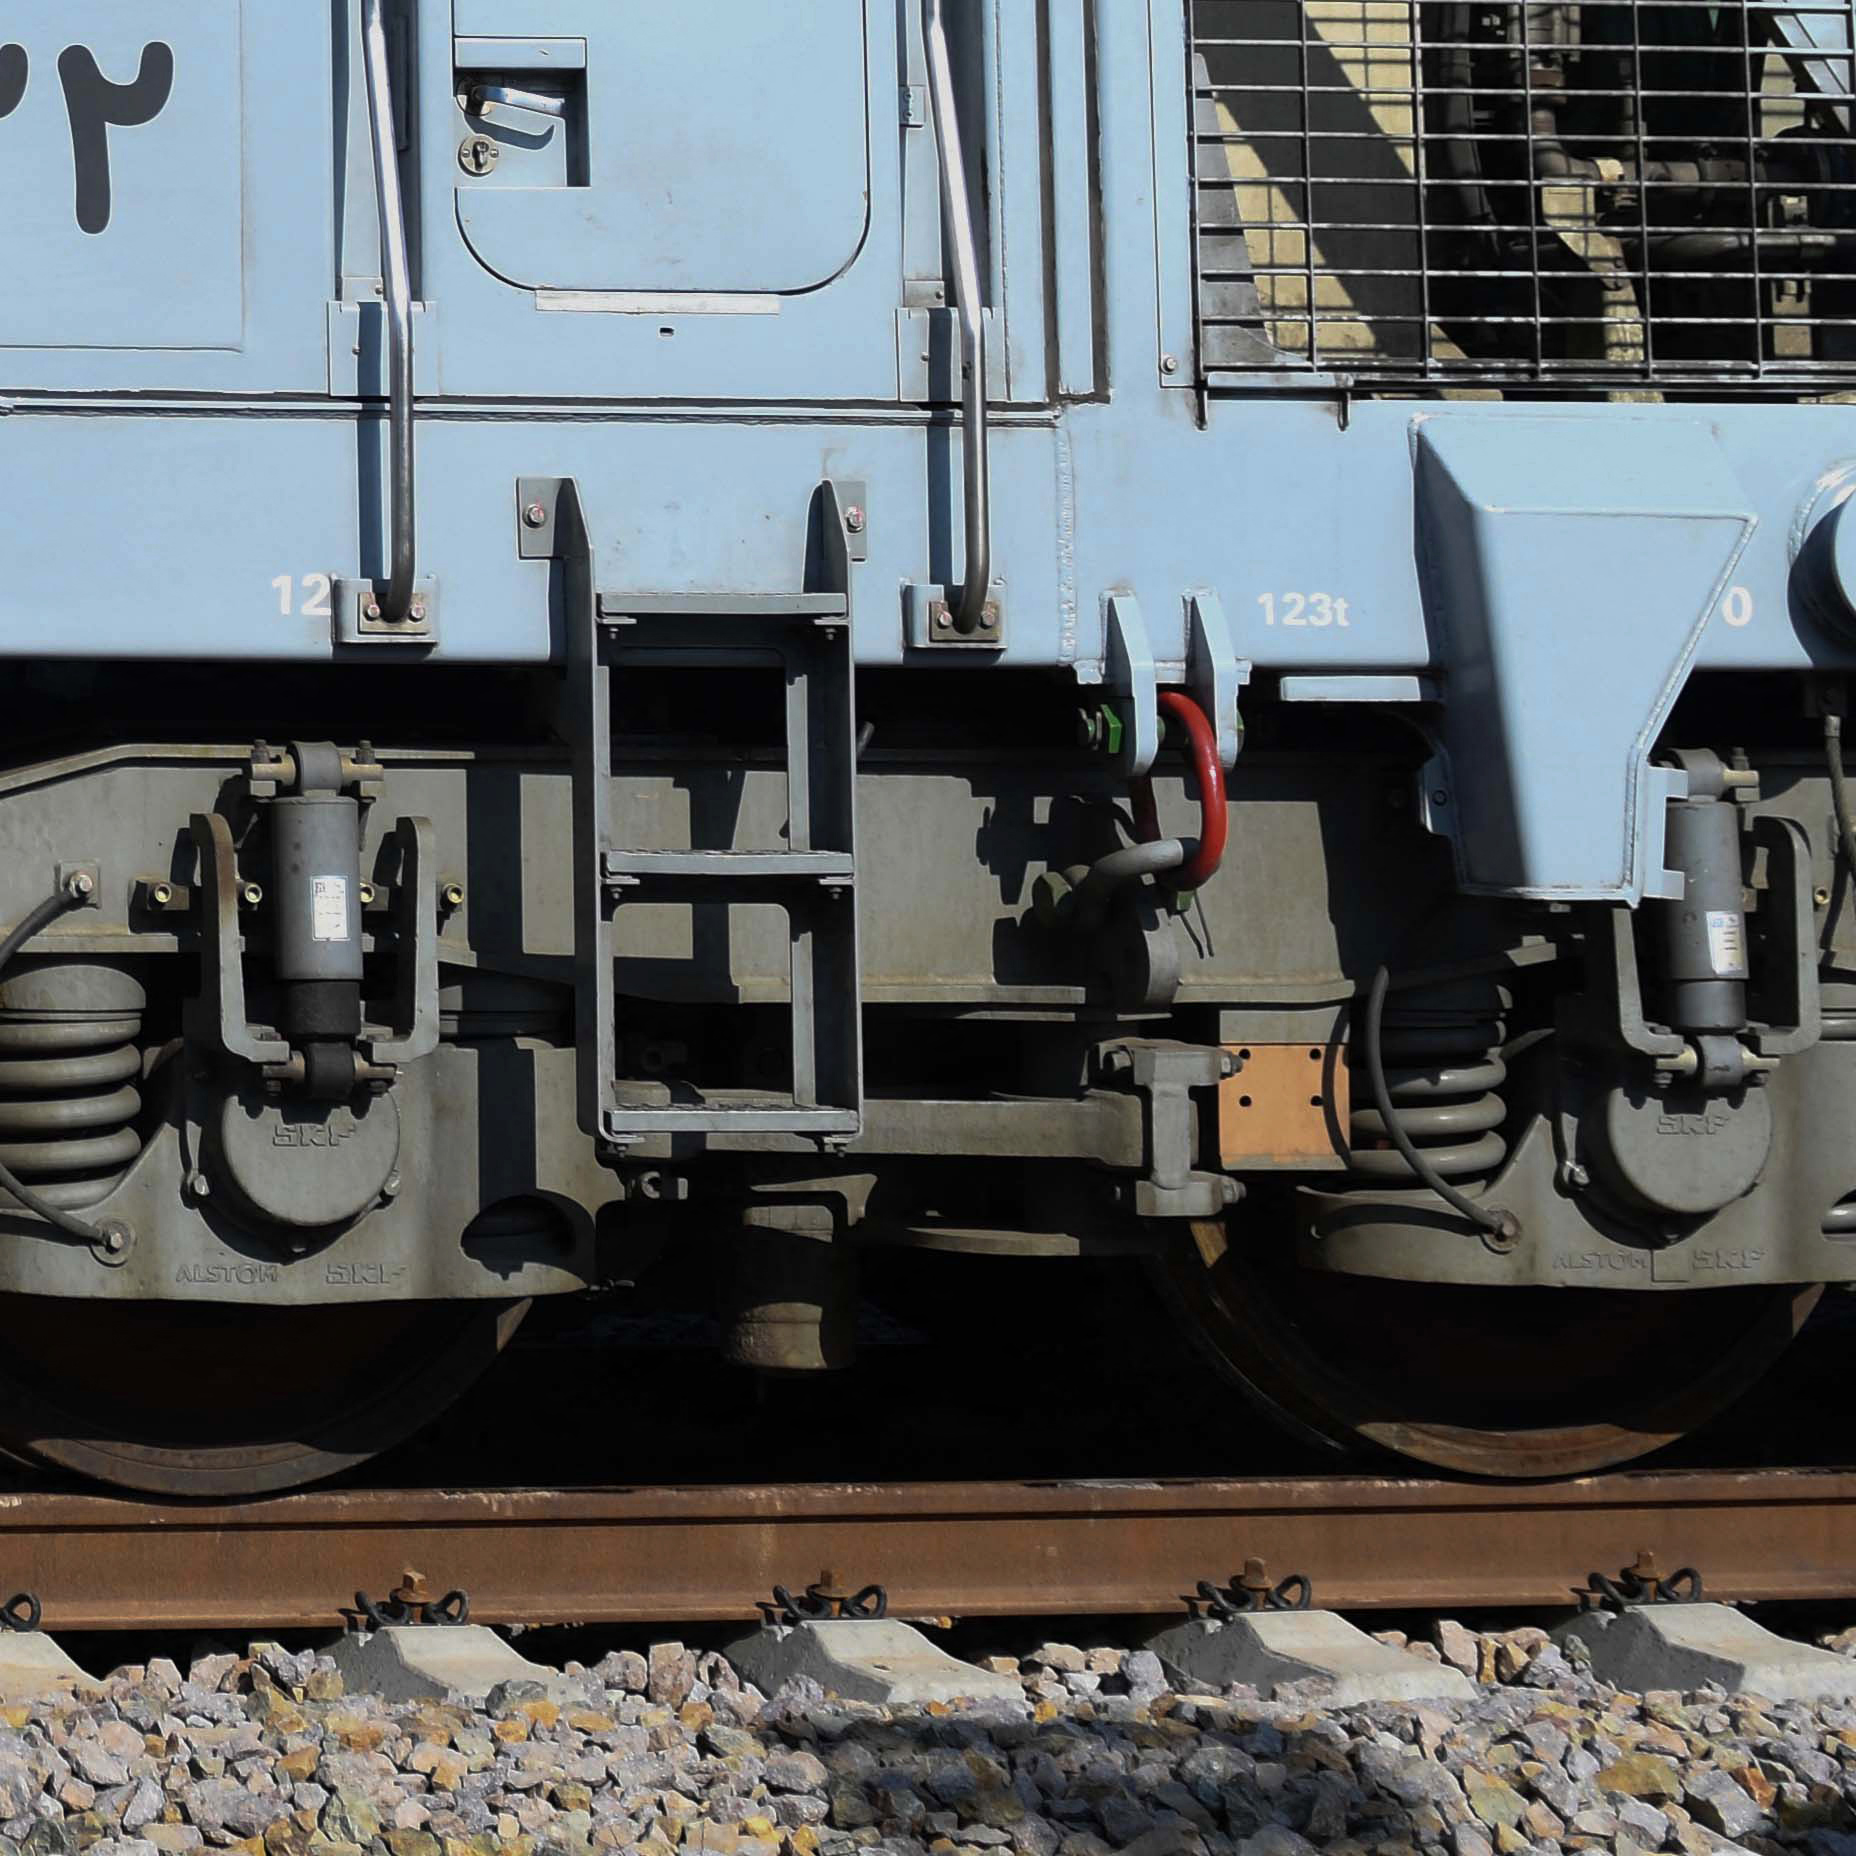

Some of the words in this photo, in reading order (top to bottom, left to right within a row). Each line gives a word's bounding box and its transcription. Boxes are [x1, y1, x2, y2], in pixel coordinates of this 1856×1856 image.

[1256, 591, 1351, 627] 123t
[272, 1123, 356, 1148] SKF
[1655, 1114, 1730, 1137] SKF
[1553, 1250, 1647, 1271] ALSTOM
[175, 1262, 279, 1286] ALSTOM
